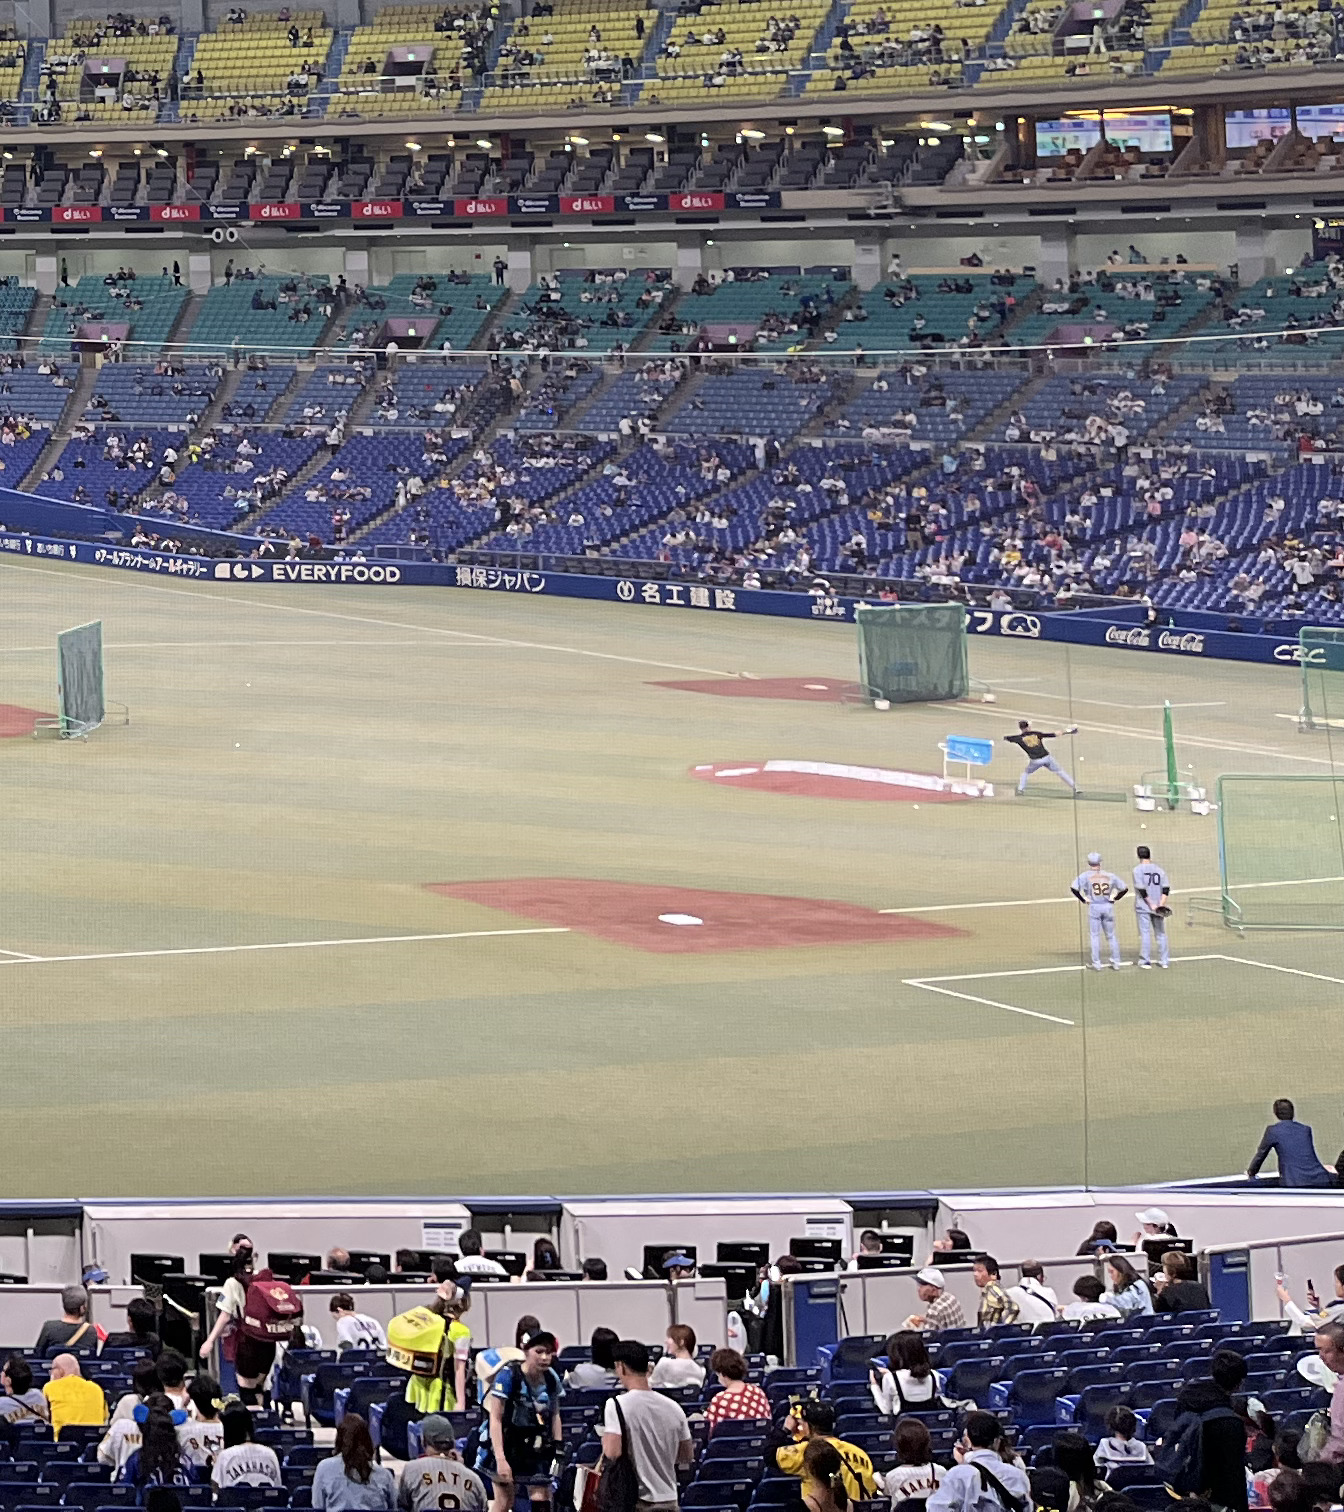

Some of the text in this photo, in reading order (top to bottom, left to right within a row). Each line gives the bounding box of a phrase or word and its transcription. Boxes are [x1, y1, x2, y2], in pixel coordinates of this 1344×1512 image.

[272, 564, 401, 583] EVERYFOOD
[455, 567, 546, 593] 損保ジャパン
[642, 581, 736, 610] 名工建設
[1274, 645, 1326, 663] CBC
[1143, 872, 1161, 886] 70
[423, 1471, 473, 1491] SATO
